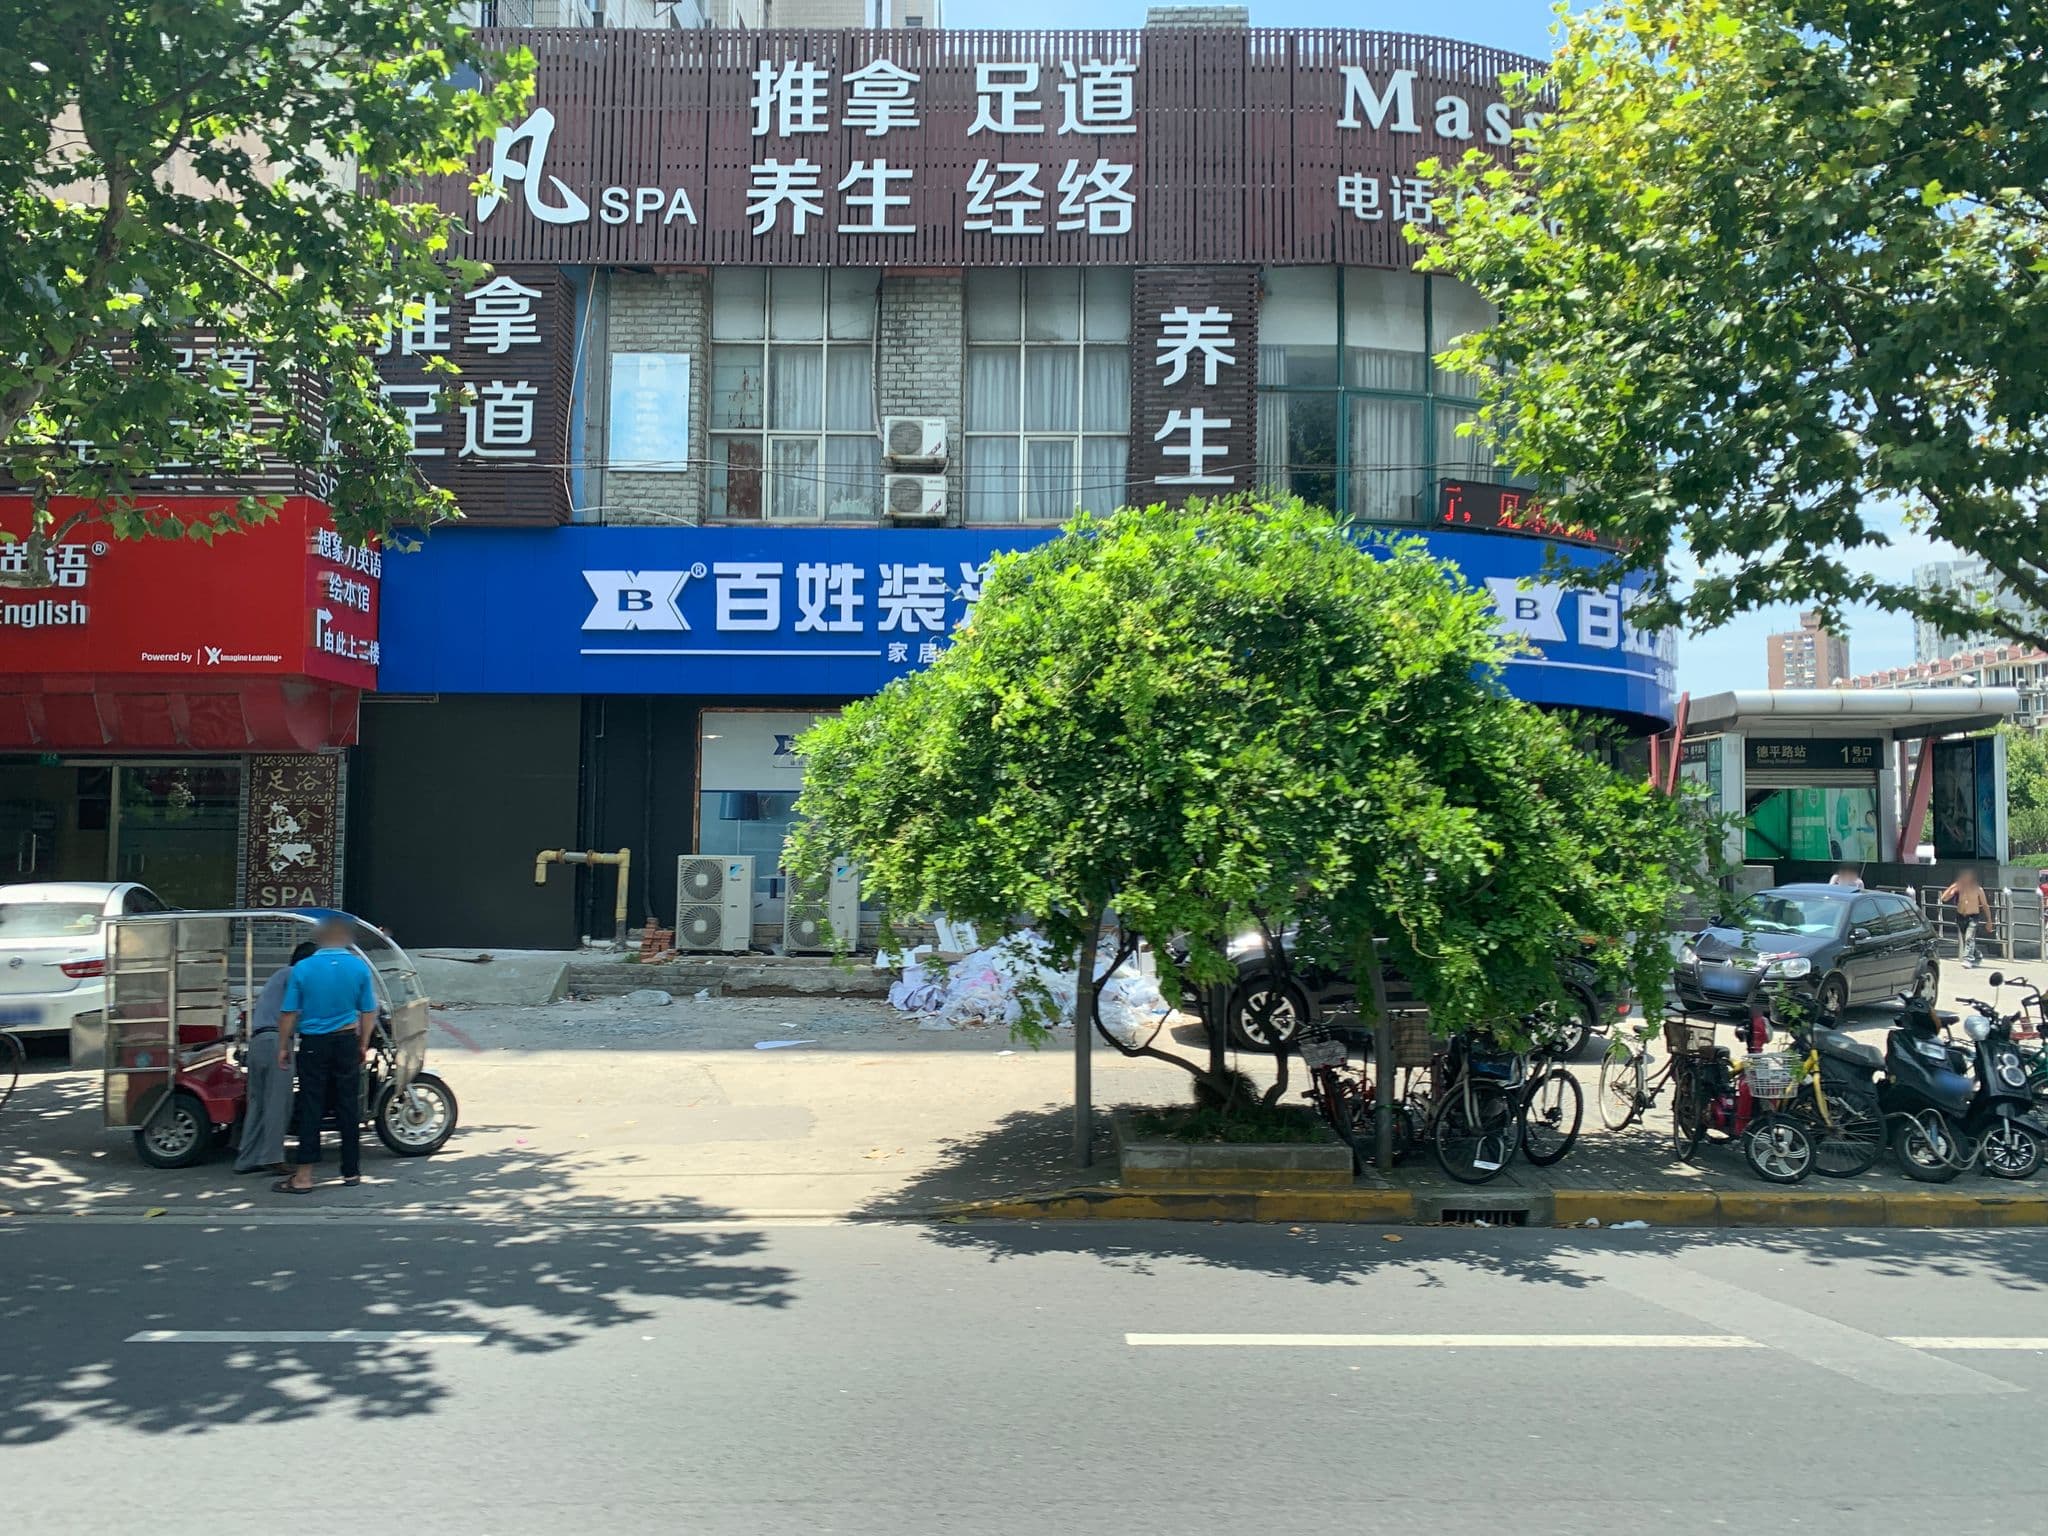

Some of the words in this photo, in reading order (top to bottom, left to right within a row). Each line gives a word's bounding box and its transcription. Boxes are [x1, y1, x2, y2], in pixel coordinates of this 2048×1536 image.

[751, 58, 921, 138] 推拿
[966, 58, 1138, 137] 足道
[599, 186, 698, 226] SPA
[745, 158, 917, 236] 养生
[963, 158, 1136, 236] 经络
[375, 276, 542, 356] 推拿
[1154, 306, 1237, 486] 养生
[379, 380, 539, 459] 足道
[329, 571, 371, 613] 绘本馆
[0, 599, 86, 628] nglish
[141, 652, 179, 662] Powered
[181, 652, 193, 663] by
[323, 626, 381, 667] 由此上二楼
[1755, 745, 1808, 758] 德平路站
[264, 768, 322, 793] 足浴
[261, 886, 317, 907] SPA
